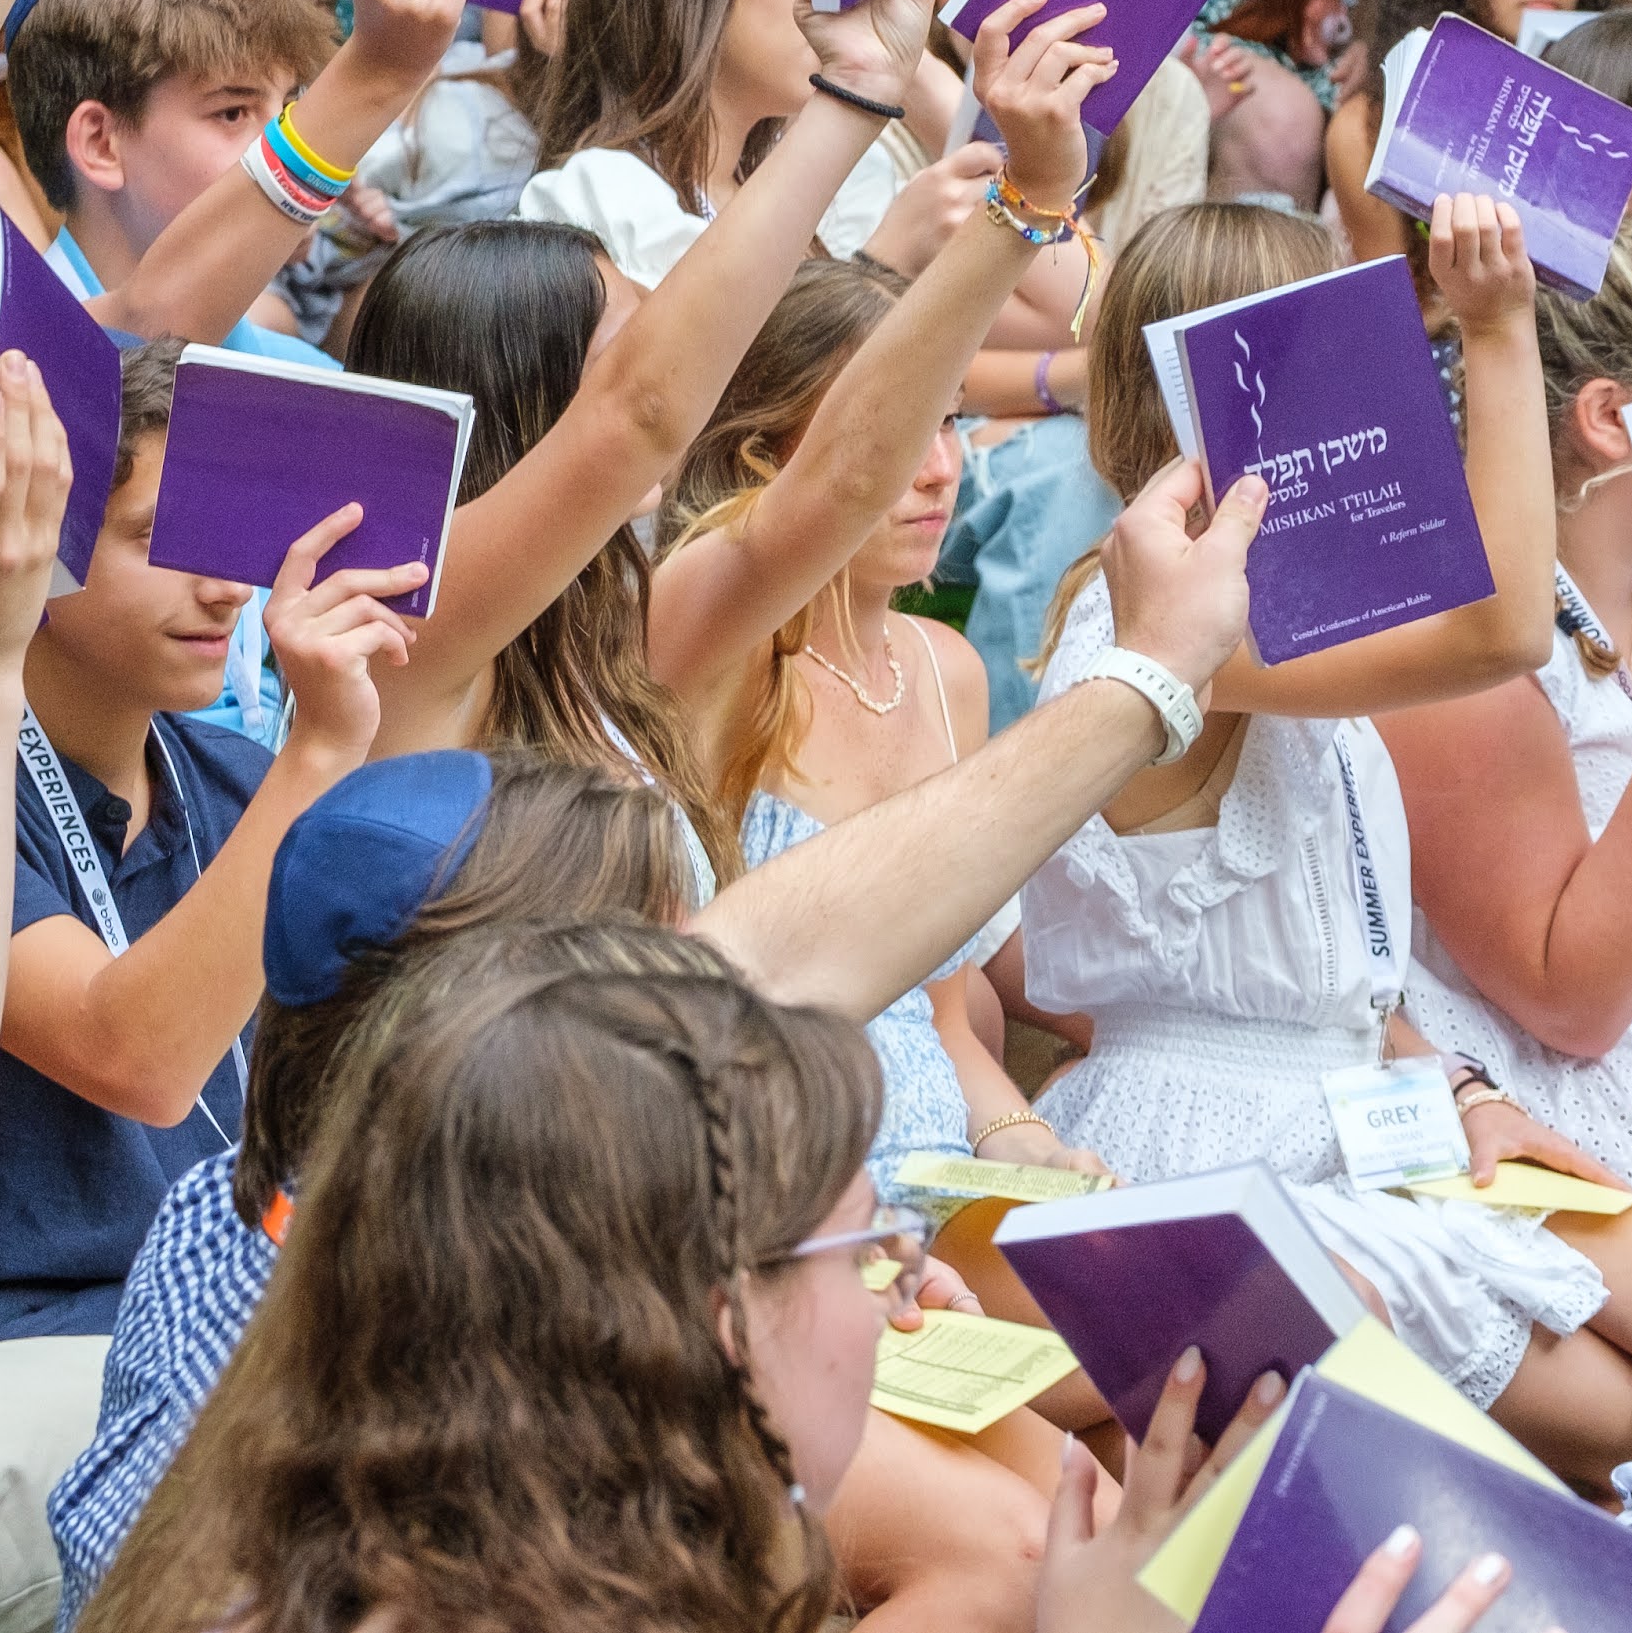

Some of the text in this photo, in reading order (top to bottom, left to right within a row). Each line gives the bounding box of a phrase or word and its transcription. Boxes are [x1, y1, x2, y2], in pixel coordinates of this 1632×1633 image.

[1484, 75, 1516, 136] MISHKAN
[1498, 143, 1530, 198] משכן
[1318, 426, 1387, 475] משכן
[1259, 481, 1402, 537] MISHKAN T'FILAH
[1350, 500, 1406, 523] for Travelers
[1379, 518, 1447, 545] A Reform Siddur
[19, 727, 96, 873] EXPERIENCES
[100, 908, 119, 946] bbyo
[1356, 866, 1390, 958] SUMMER
[1367, 1104, 1420, 1129] GREY
